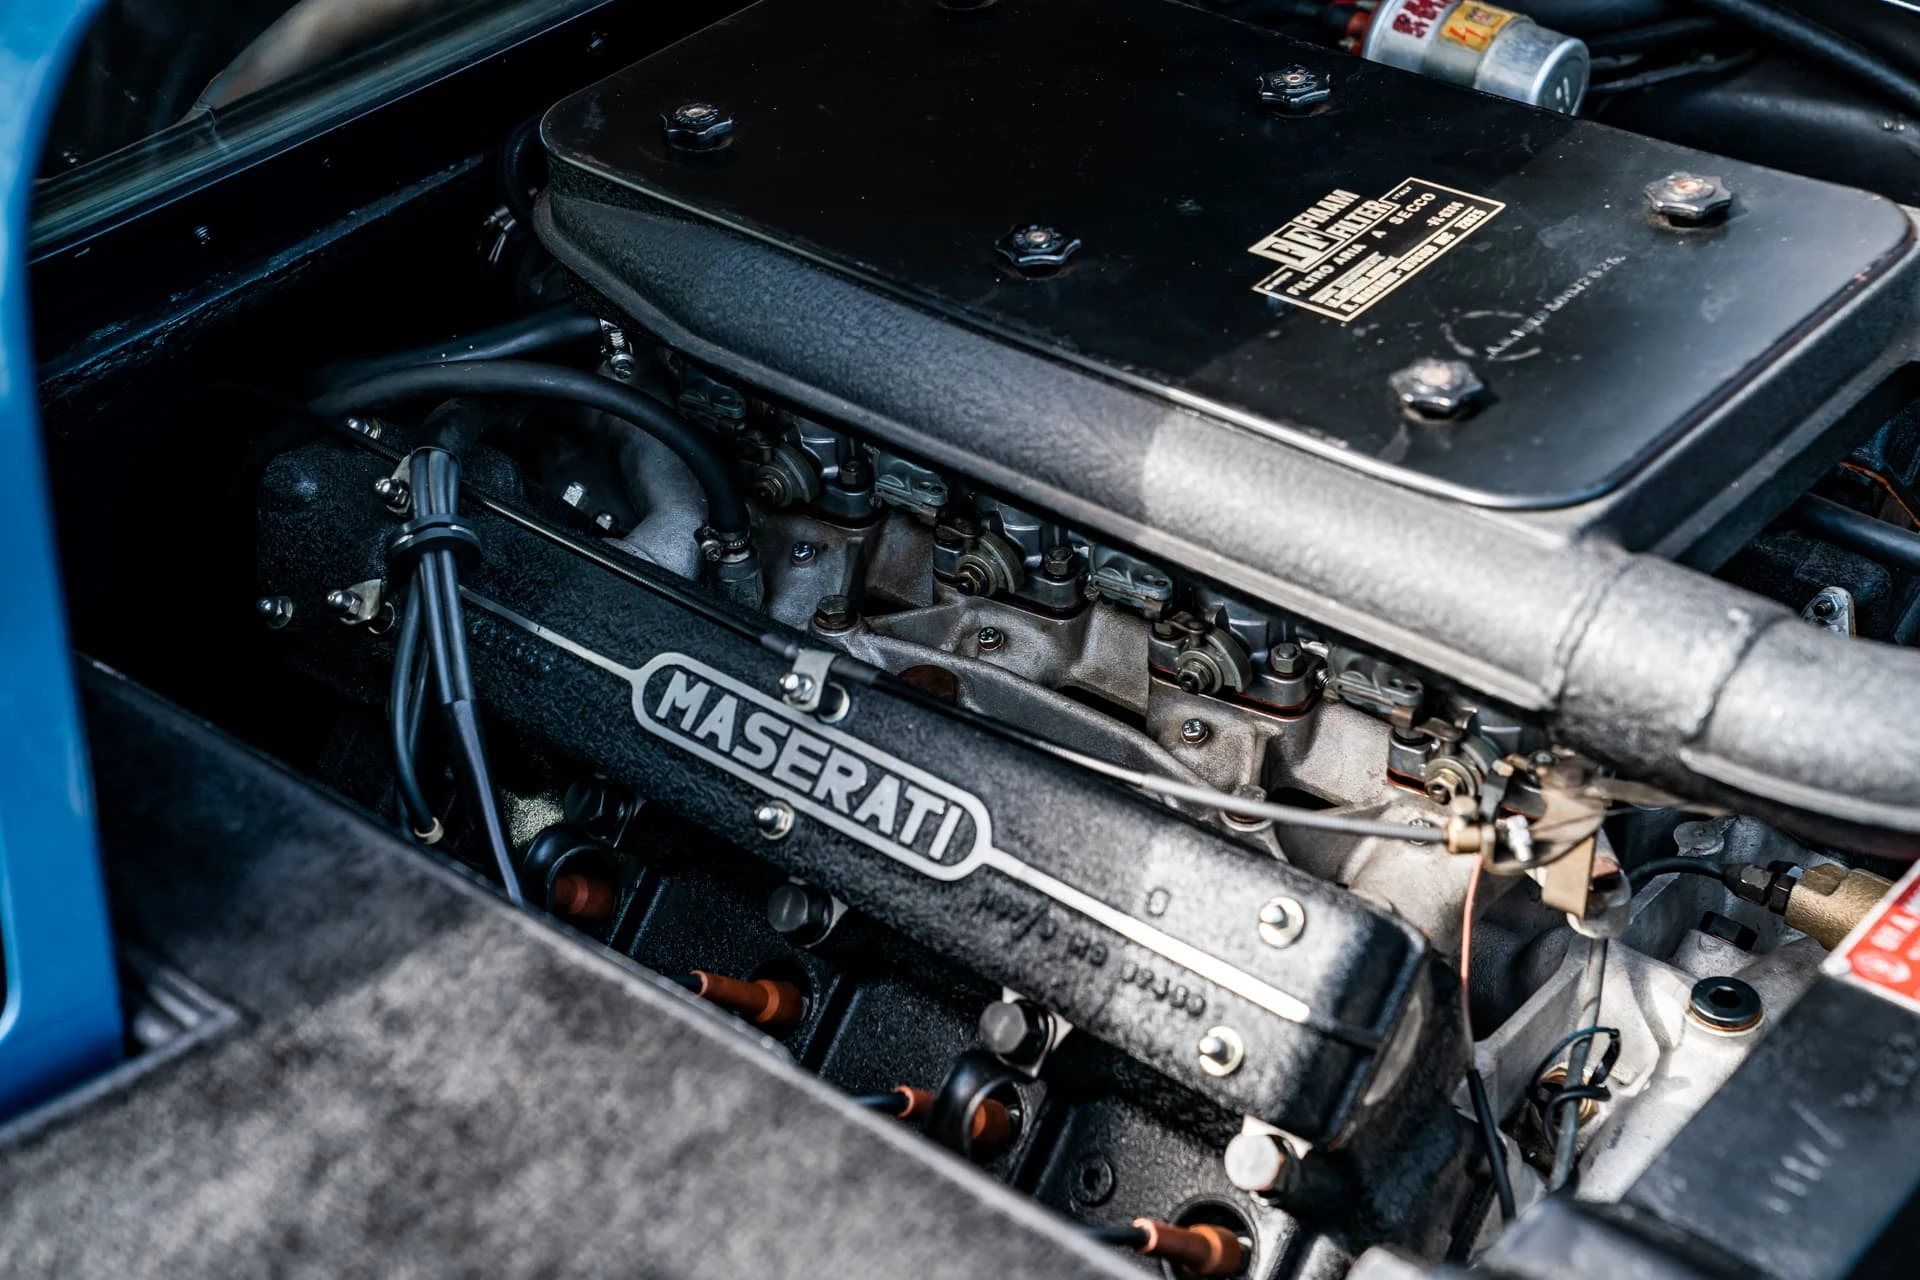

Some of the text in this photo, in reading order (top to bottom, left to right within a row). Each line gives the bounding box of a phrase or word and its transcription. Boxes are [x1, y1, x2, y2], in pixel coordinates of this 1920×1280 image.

[1286, 264, 1335, 296] FILTRO
[1336, 243, 1368, 266] ARIA
[1369, 230, 1388, 240] A
[1389, 192, 1437, 225] SECCO
[1325, 199, 1394, 239] FILTER
[654, 669, 964, 861] MASERATI
